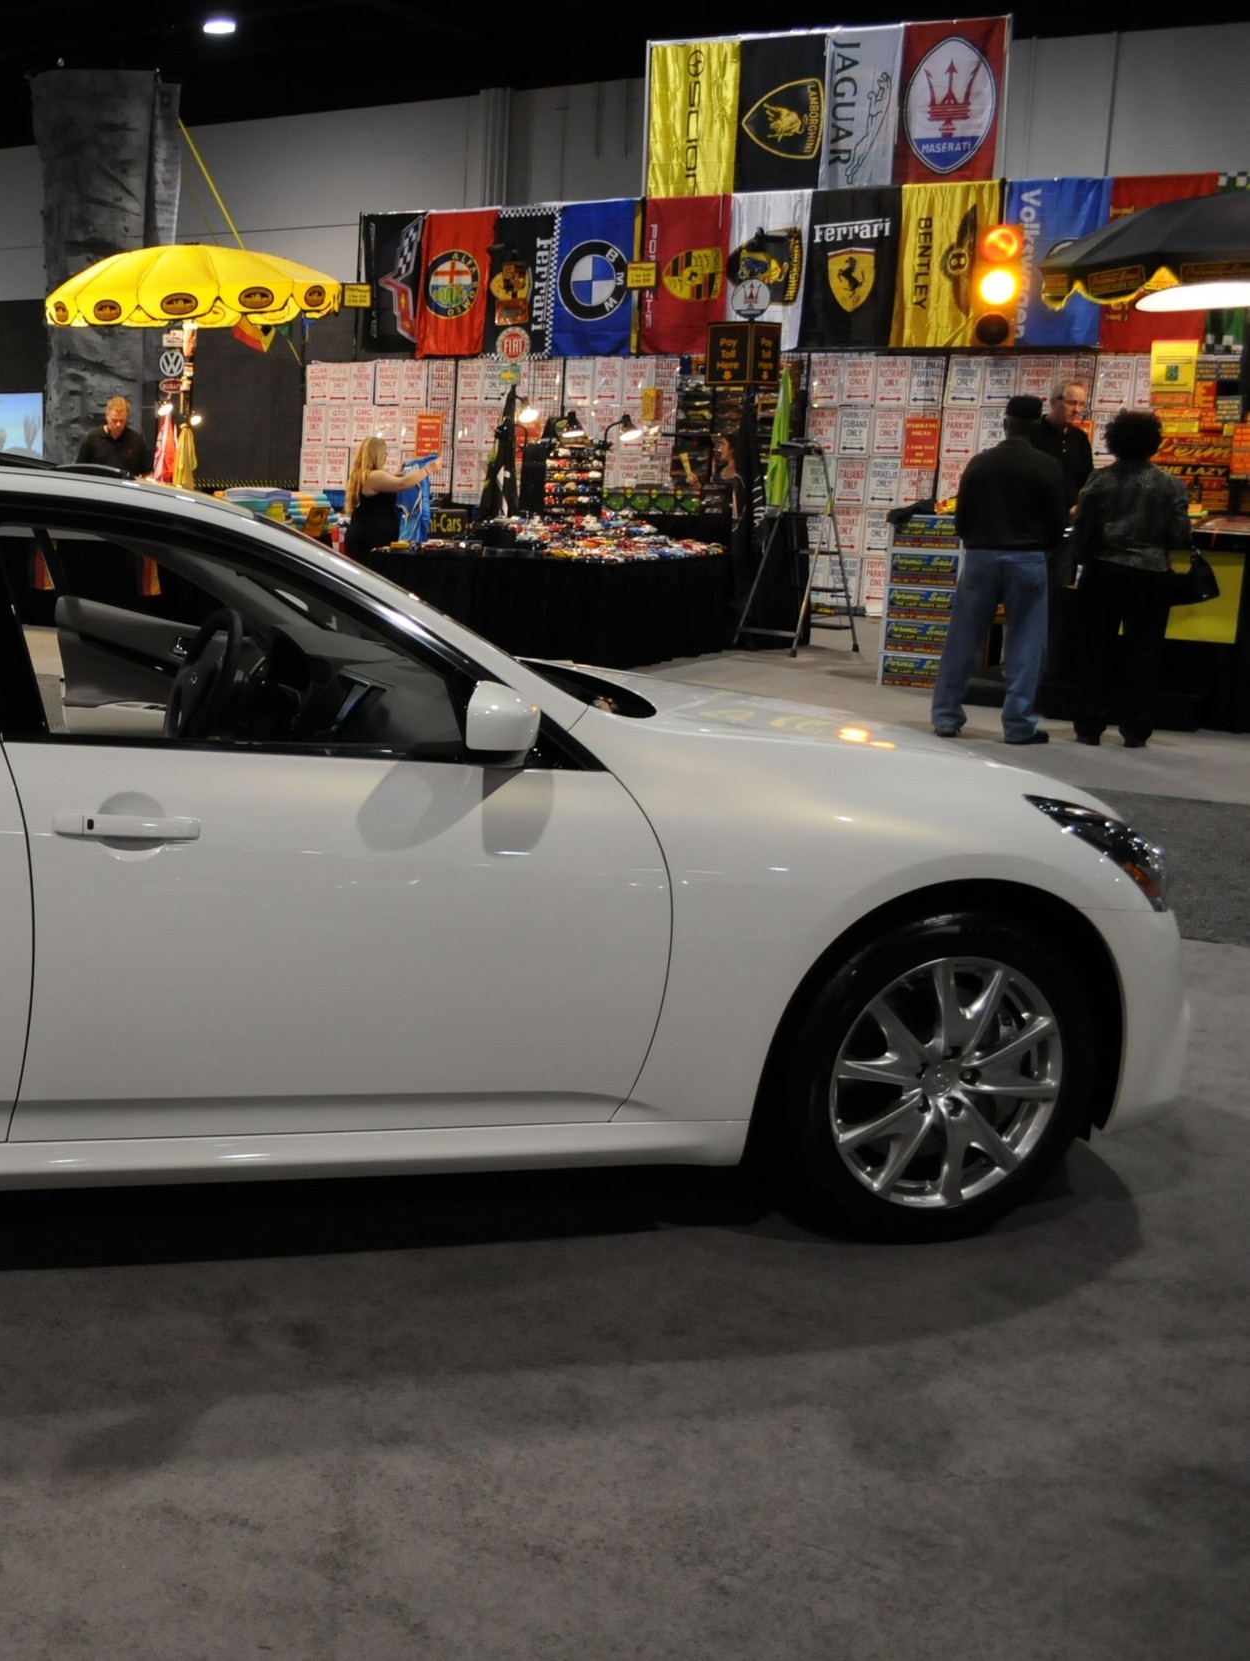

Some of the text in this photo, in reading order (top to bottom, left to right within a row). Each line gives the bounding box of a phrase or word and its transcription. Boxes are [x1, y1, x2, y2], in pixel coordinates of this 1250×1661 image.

[828, 40, 861, 166] JAGUAR
[803, 84, 820, 153] LAMBORGHINI
[921, 141, 972, 154] MASERATI
[813, 218, 890, 243] Ferrari
[913, 216, 933, 310] BENTLEY
[531, 236, 553, 332] Ferrari
[503, 338, 524, 355] FIAT
[720, 338, 738, 347] Pay
[721, 350, 736, 358] Toll
[716, 362, 740, 370] Here
[990, 369, 1011, 378] BRITS
[1022, 369, 1052, 378] PARKING
[990, 378, 1010, 386] ONLY
[1026, 378, 1046, 387] ONLY
[1104, 382, 1124, 390] ONLY
[946, 412, 974, 421] EGYPTIAN
[843, 420, 867, 428] CUBANS
[946, 421, 974, 430] PARKING
[846, 429, 863, 437] ONLY
[879, 429, 897, 437] ONLY
[950, 430, 968, 439] ONLY
[838, 470, 864, 479] ITALIANS
[1186, 466, 1227, 476] LAZY
[876, 480, 892, 488] ONLY
[867, 520, 888, 529] SWEDE
[870, 530, 887, 538] ONLY
[931, 556, 955, 566] Seal
[928, 592, 952, 602] Seal
